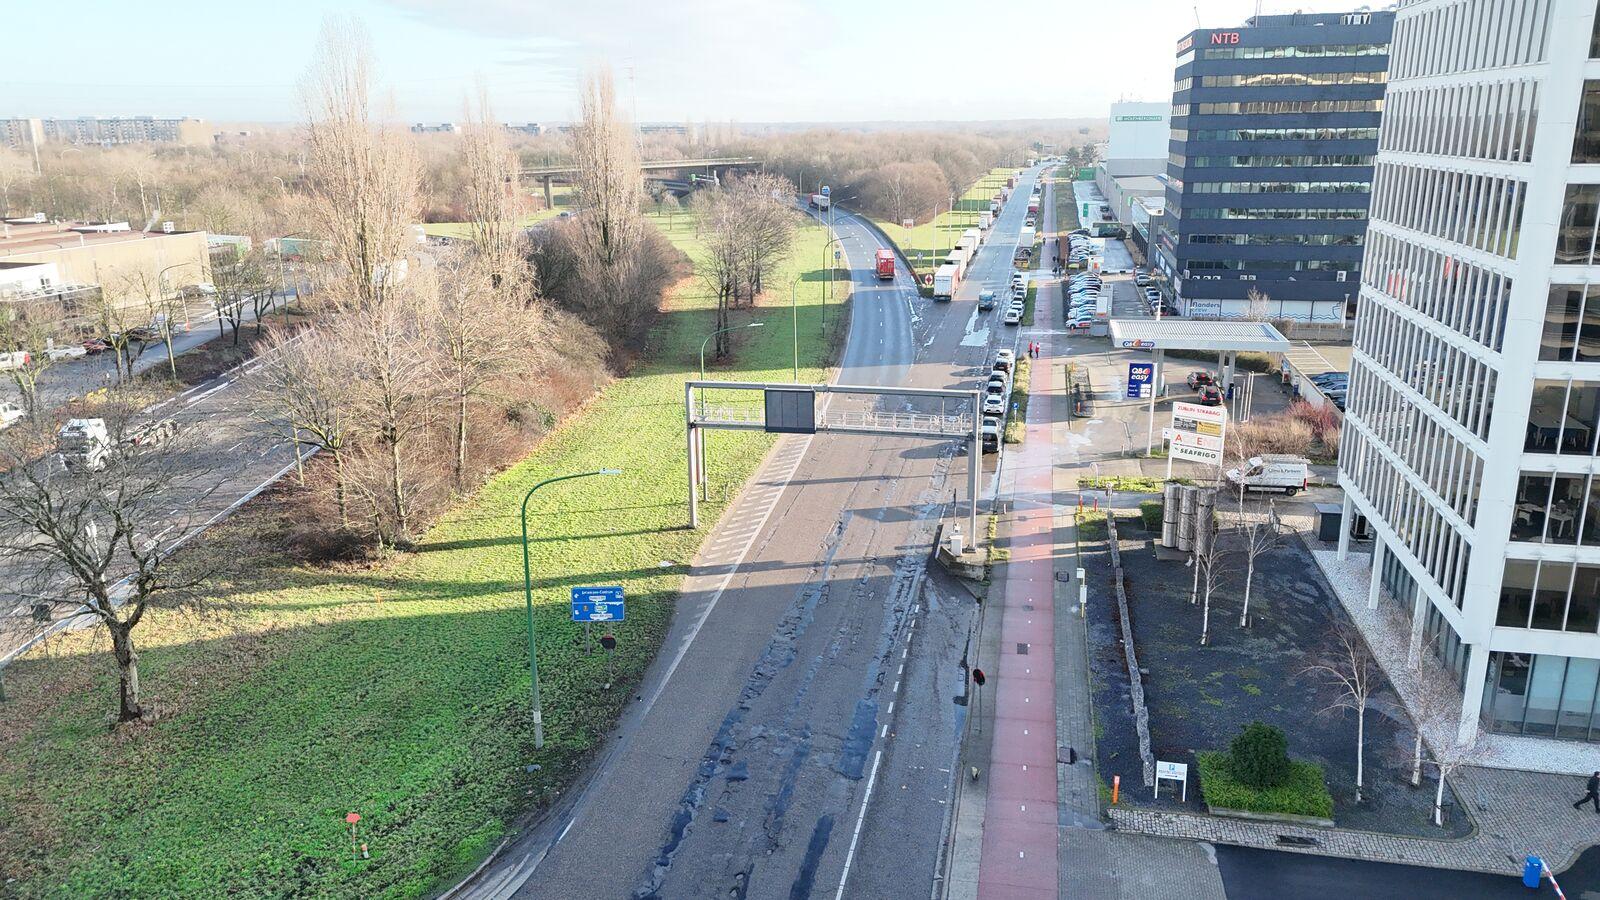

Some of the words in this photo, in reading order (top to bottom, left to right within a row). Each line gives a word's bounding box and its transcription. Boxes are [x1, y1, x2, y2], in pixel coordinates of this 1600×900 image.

[1211, 32, 1240, 44] NTB
[1131, 367, 1143, 375] Q8
[1131, 374, 1149, 382] easy
[1180, 449, 1216, 459] SEAFRIGO
